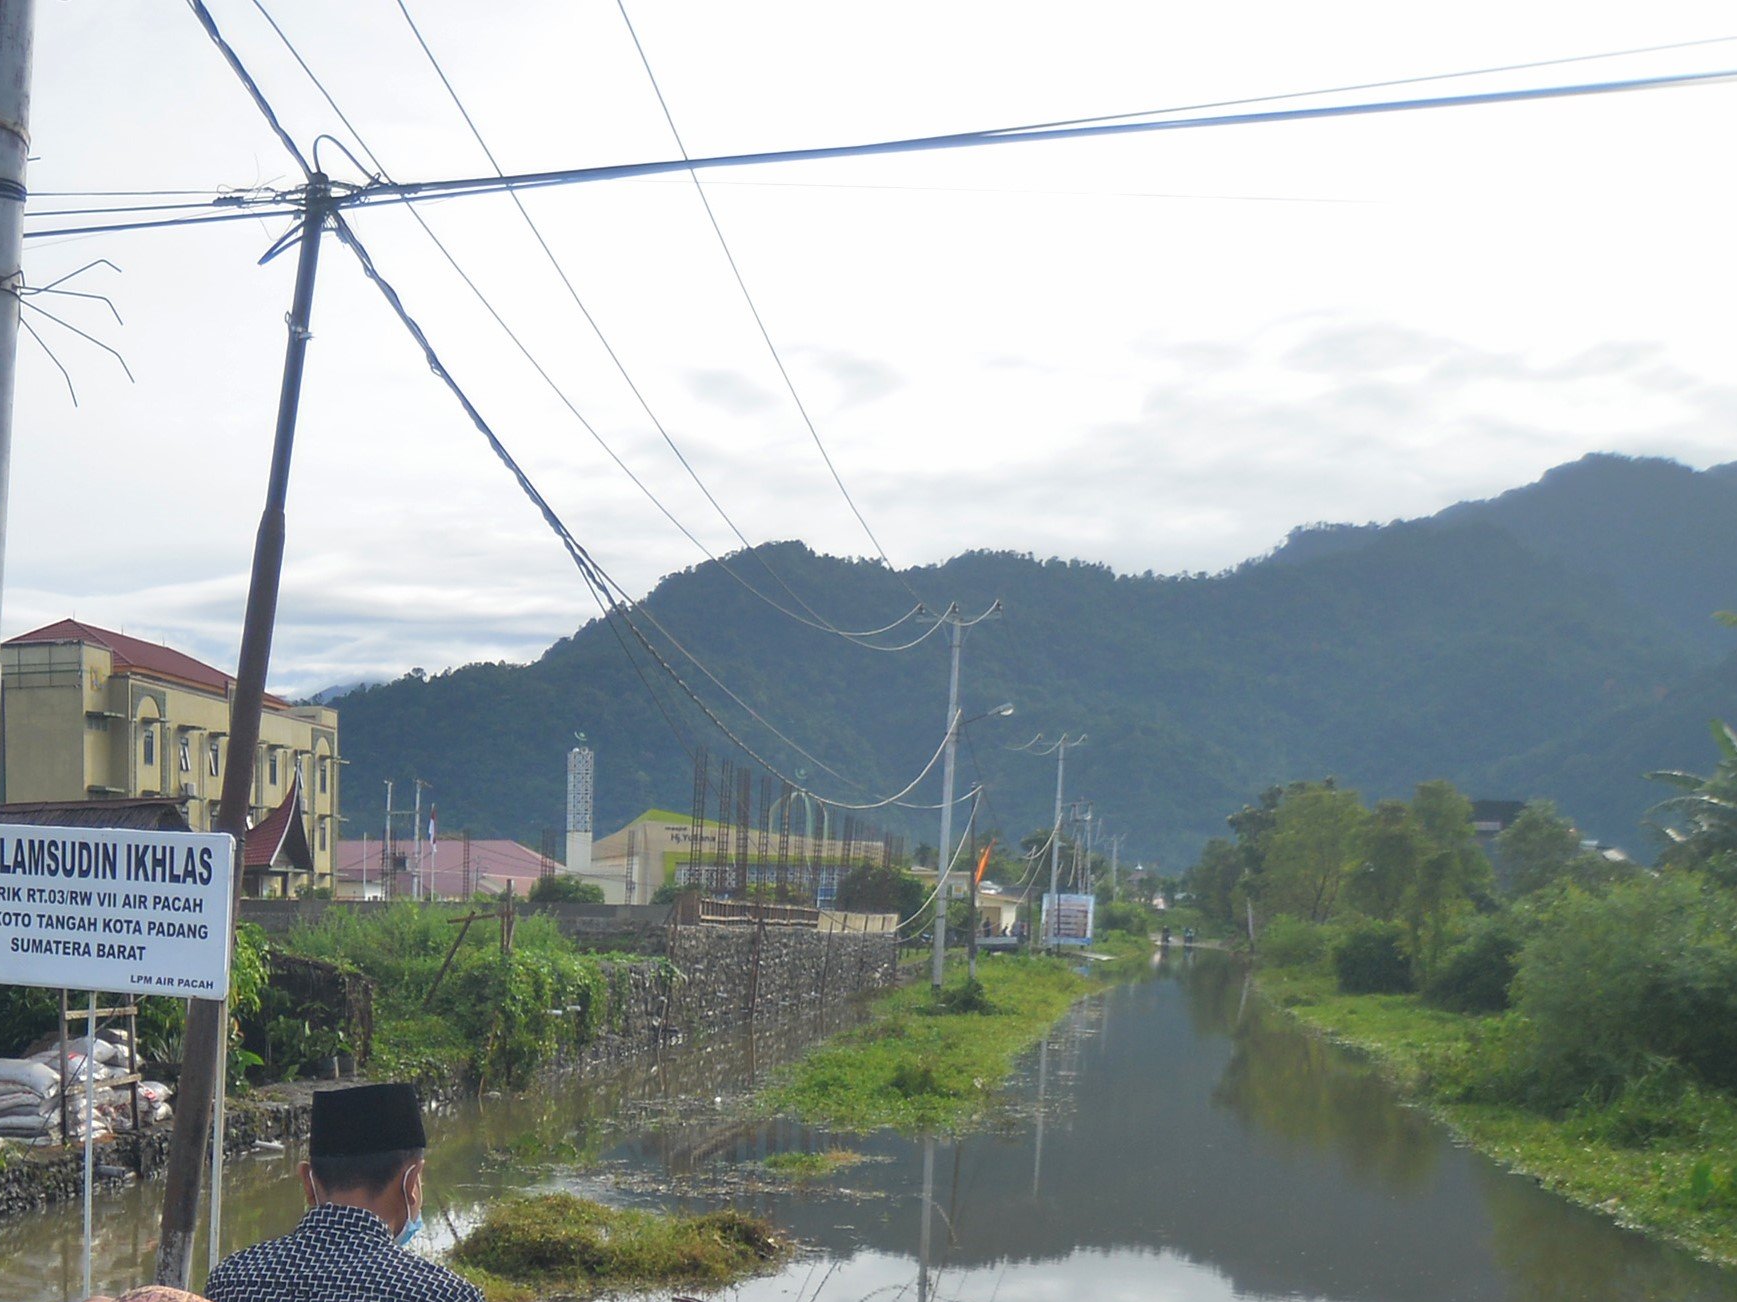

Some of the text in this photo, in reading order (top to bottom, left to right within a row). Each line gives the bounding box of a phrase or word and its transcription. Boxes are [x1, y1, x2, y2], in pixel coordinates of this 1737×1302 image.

[0, 838, 117, 881] LAMSUDIN
[126, 843, 213, 886] IKHLAS
[27, 889, 93, 908] RT.03/RW
[98, 892, 117, 908] VII
[122, 894, 148, 911] AIR
[152, 895, 204, 914] PACAH
[37, 914, 97, 932] TANGAH
[102, 918, 142, 936] KOTA
[147, 922, 209, 940] PADANG
[11, 937, 146, 962] SUMATERA BARAT
[130, 974, 214, 990] LPM AIR PACAH
